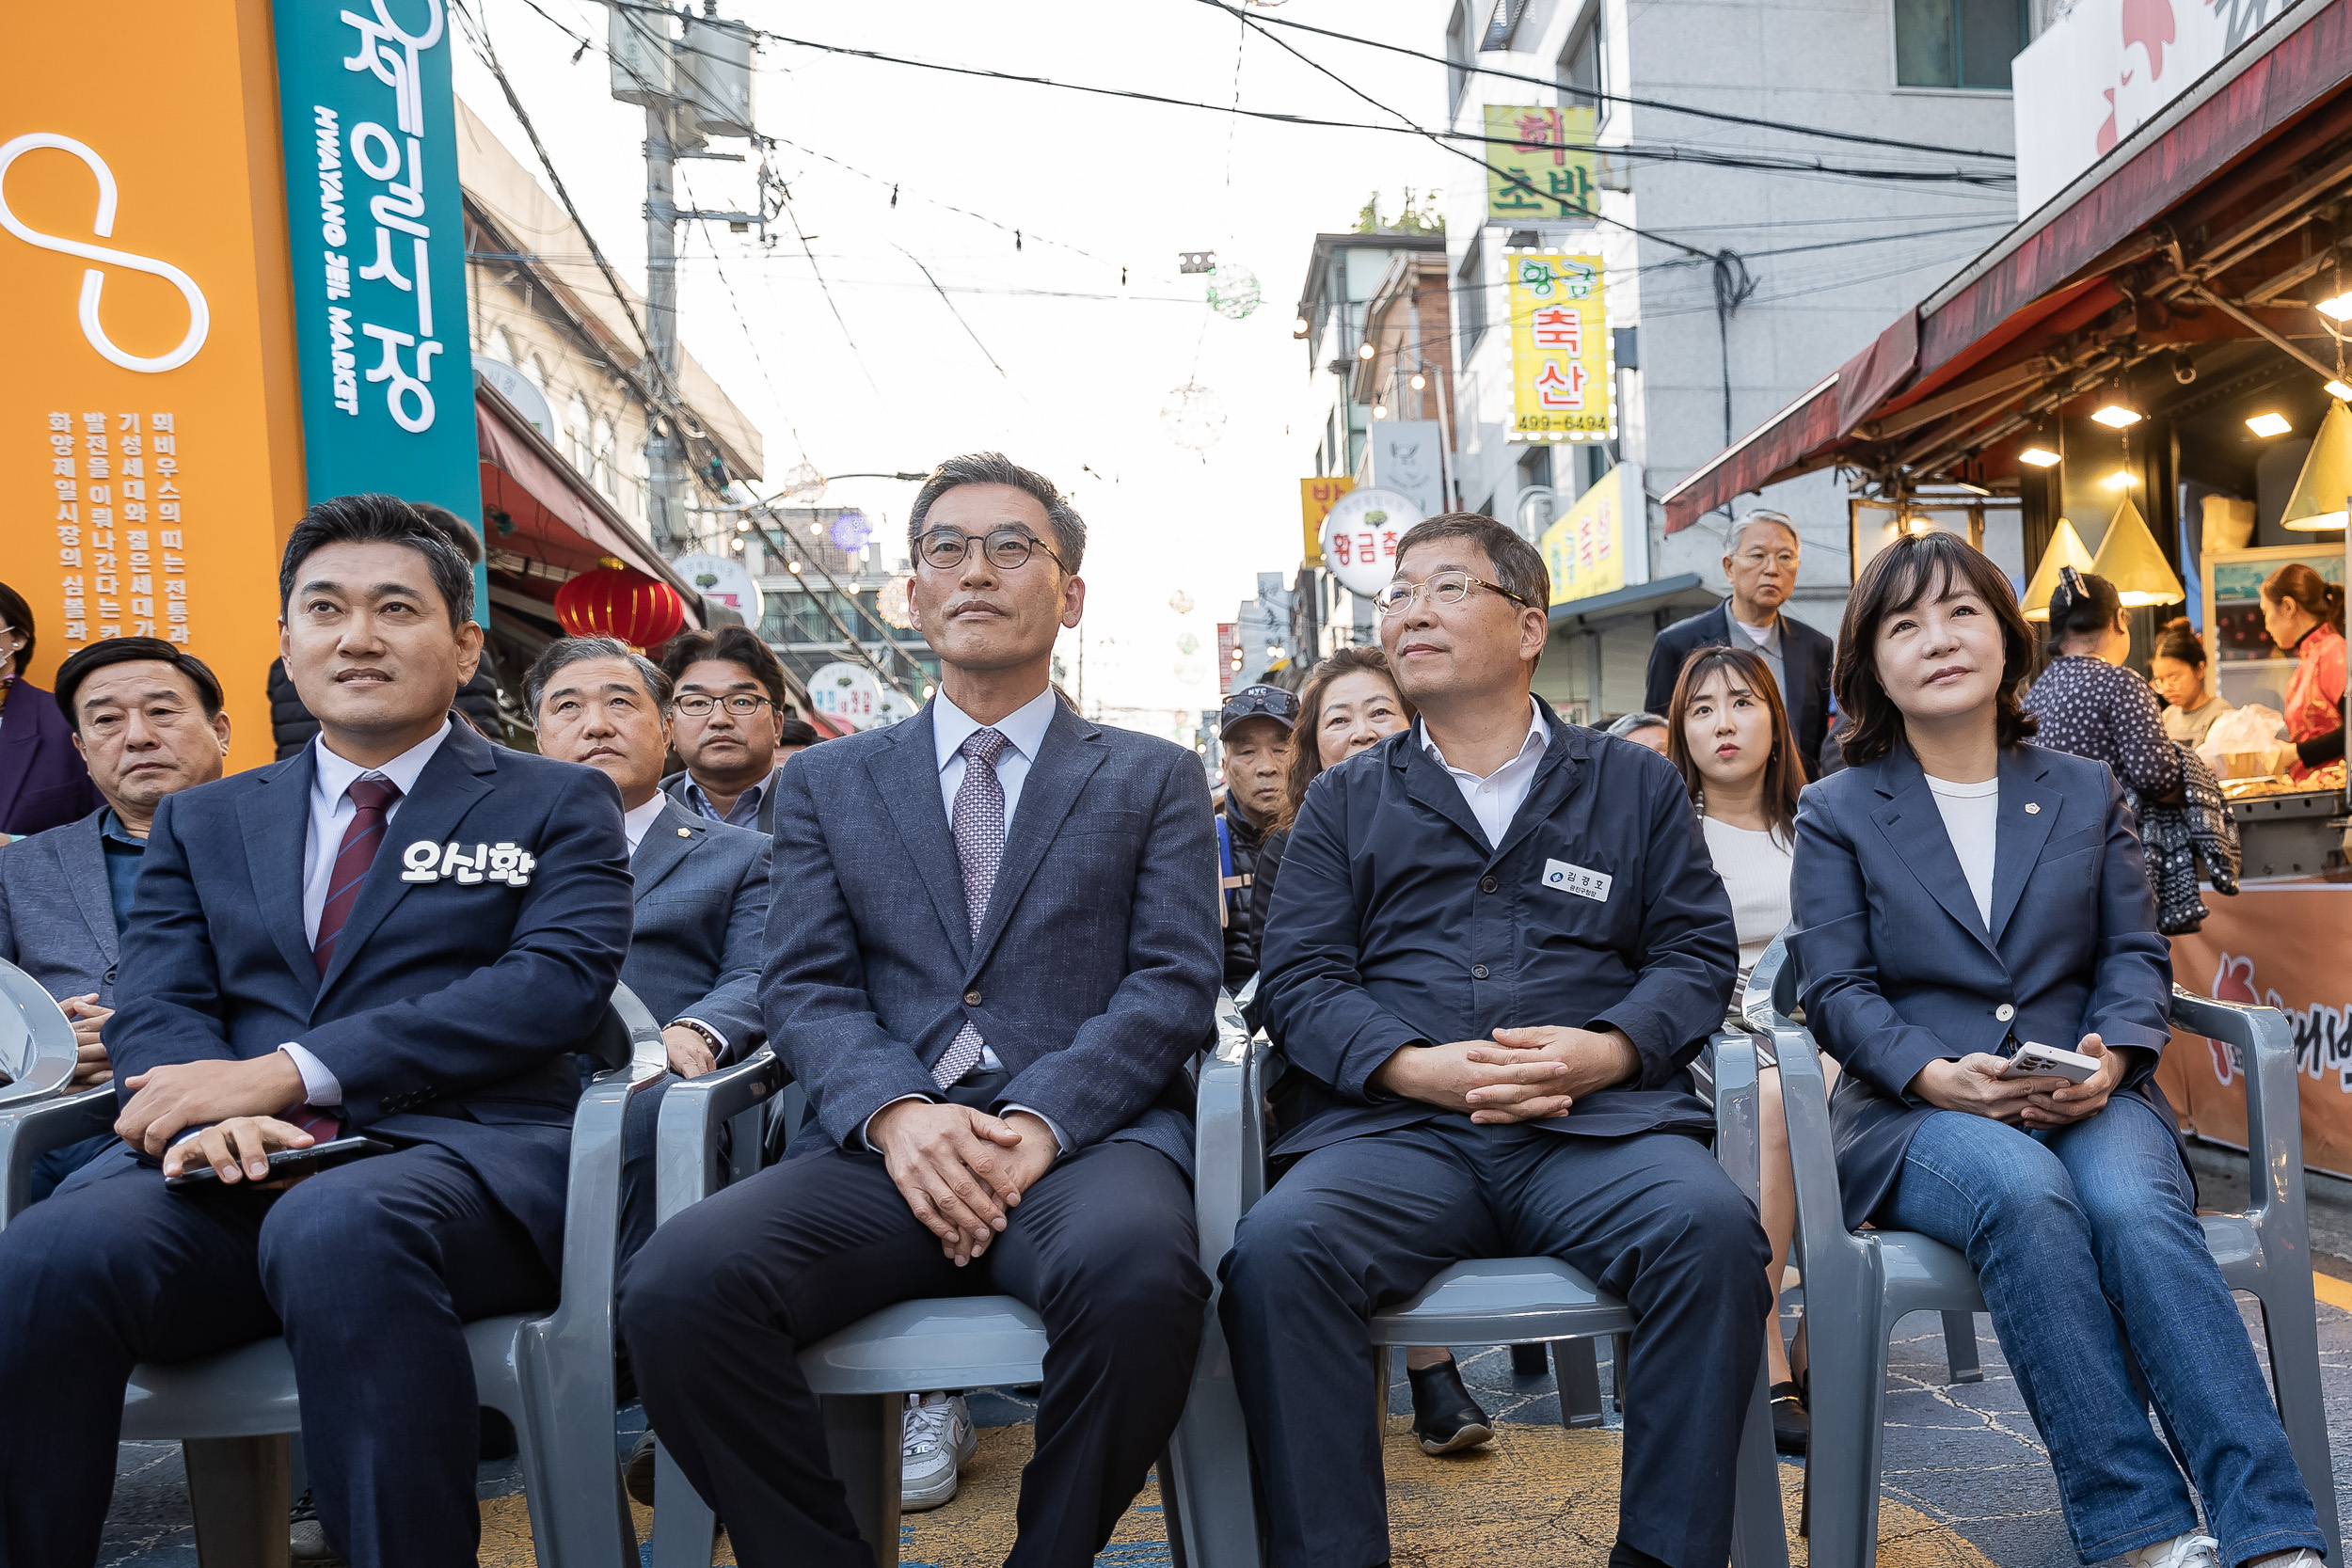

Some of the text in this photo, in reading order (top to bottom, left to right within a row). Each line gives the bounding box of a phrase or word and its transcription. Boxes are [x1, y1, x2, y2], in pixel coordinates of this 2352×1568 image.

[1493, 166, 1594, 217] 초밥
[324, 250, 352, 301] JEIL
[1518, 258, 1597, 297] 황금
[327, 306, 359, 416] MARKET
[1536, 309, 1584, 404] 축산
[82, 412, 111, 479] 발전을
[1518, 415, 1607, 431] 499-6494
[48, 411, 83, 569] 화양제일시장의
[118, 412, 149, 523] 기성세대와
[151, 412, 182, 523] 뫼비우스의
[1333, 531, 1399, 566] 황금축
[61, 575, 90, 641] 심볼과
[164, 579, 192, 644] 전통과
[1248, 687, 1268, 696] NYC
[401, 840, 537, 886] 오신환
